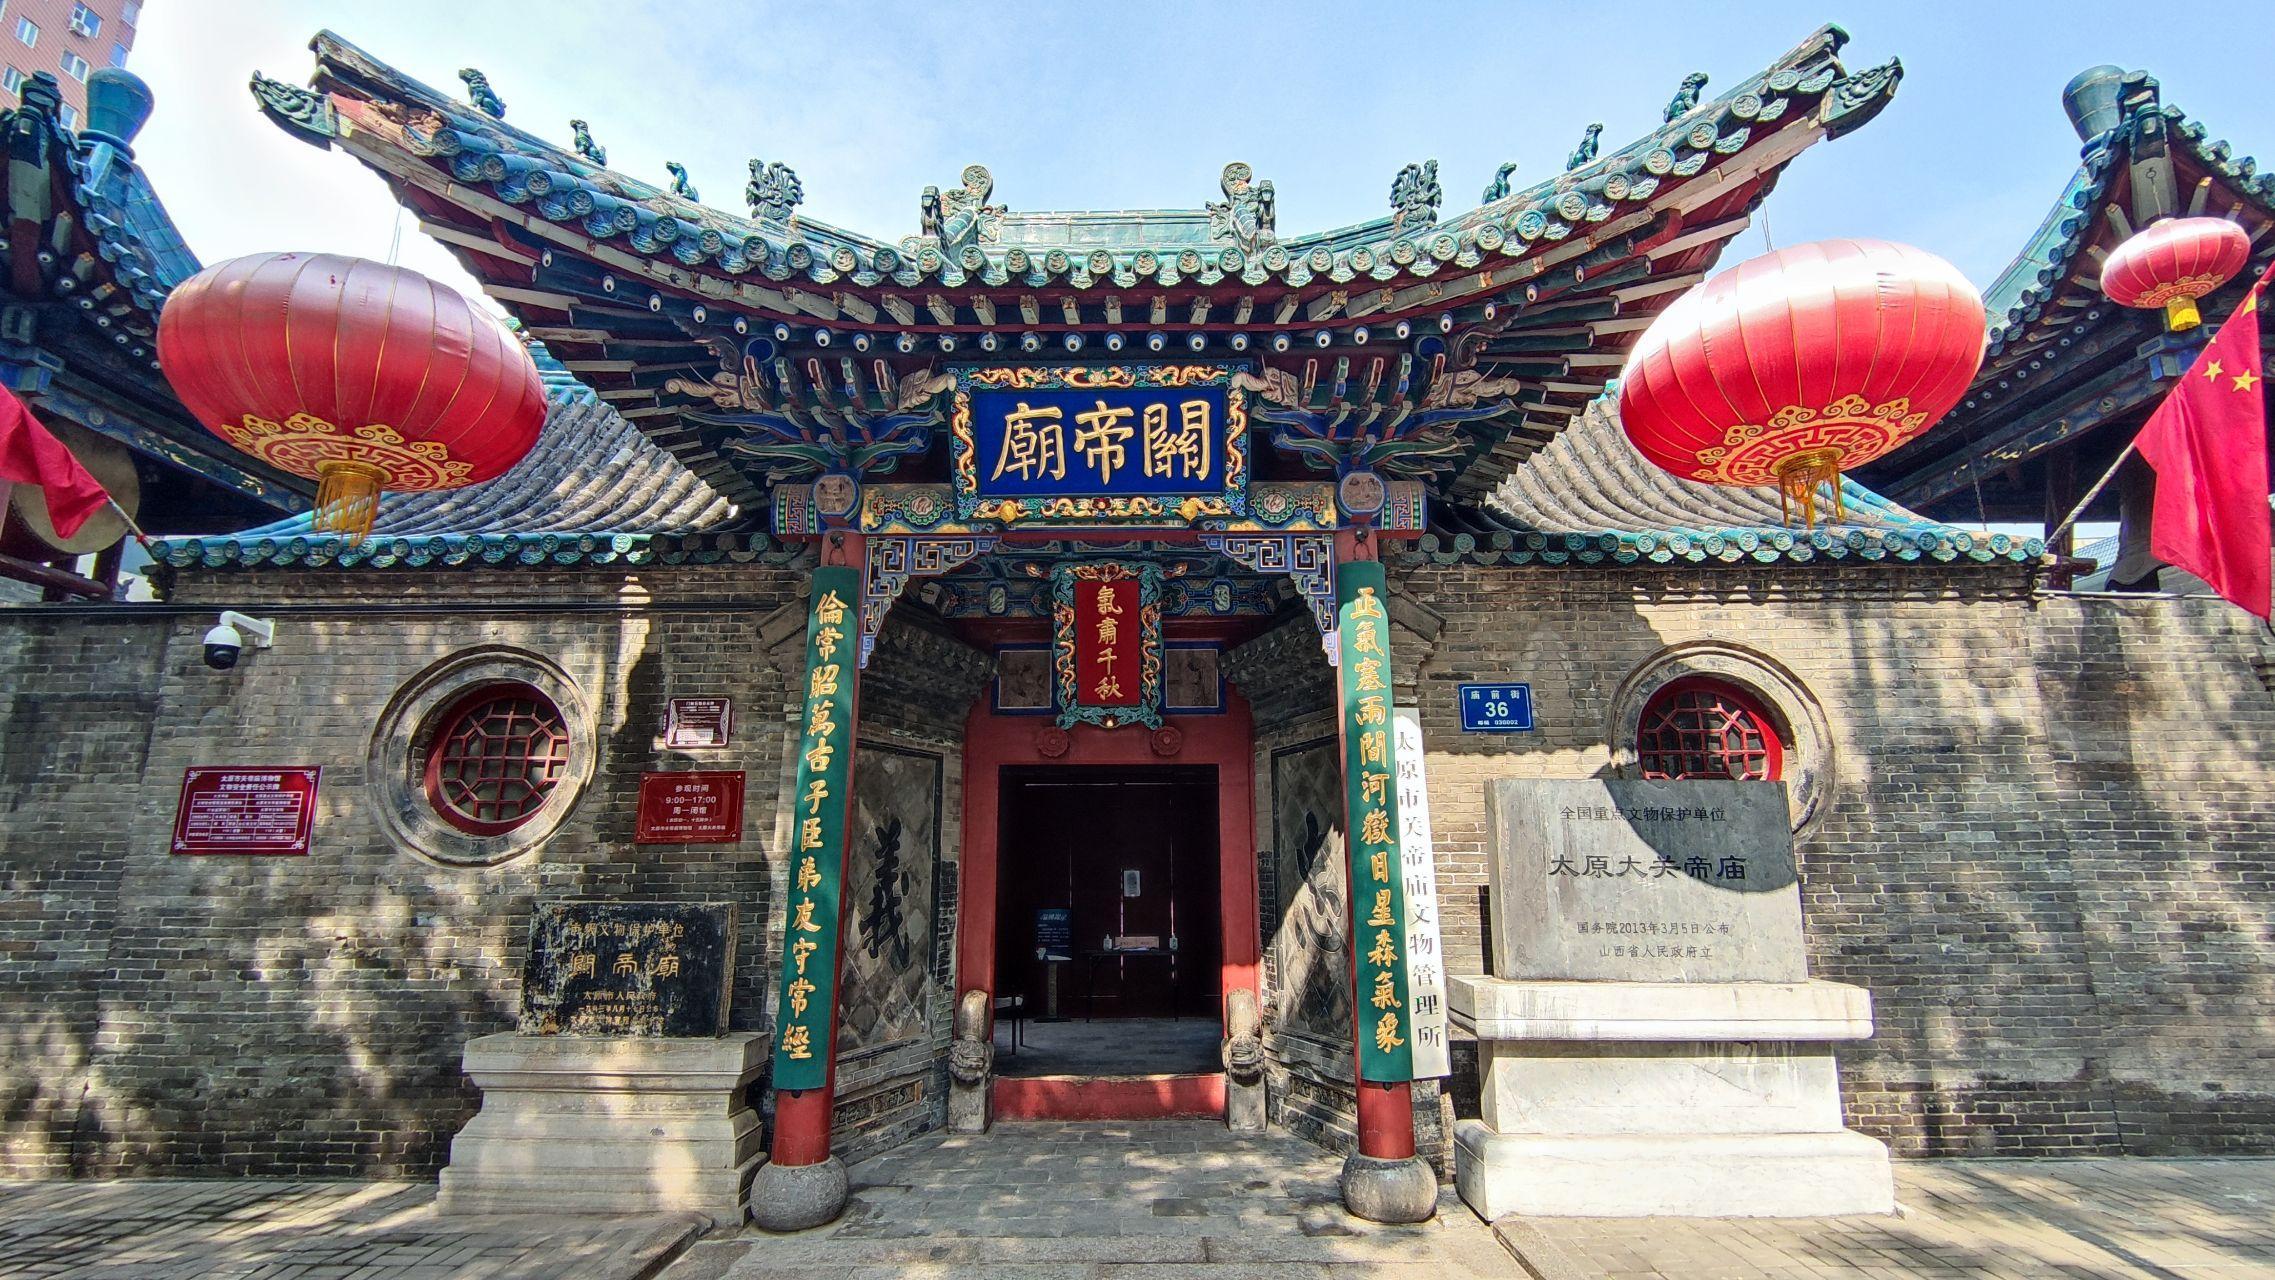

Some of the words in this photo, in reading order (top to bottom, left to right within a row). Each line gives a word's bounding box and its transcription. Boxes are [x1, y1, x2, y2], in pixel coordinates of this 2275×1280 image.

[1094, 585, 1124, 700] 氣肅千秋
[1470, 689, 1520, 700] 庙前街
[1485, 701, 1509, 718] 36
[675, 784, 710, 793] 参观时间
[672, 806, 708, 815] 周一闭馆
[1560, 806, 1726, 821] 全国重点文物保护单位
[1547, 854, 1747, 880] 太原大关帝庙
[1395, 731, 1441, 1049] 太原市关帝庙文物管理所
[1577, 921, 1730, 936] 国务院2013年3月5日公布
[1599, 945, 1713, 958] 山西省人民政府立
[583, 990, 657, 1001] 太原市人民政府
